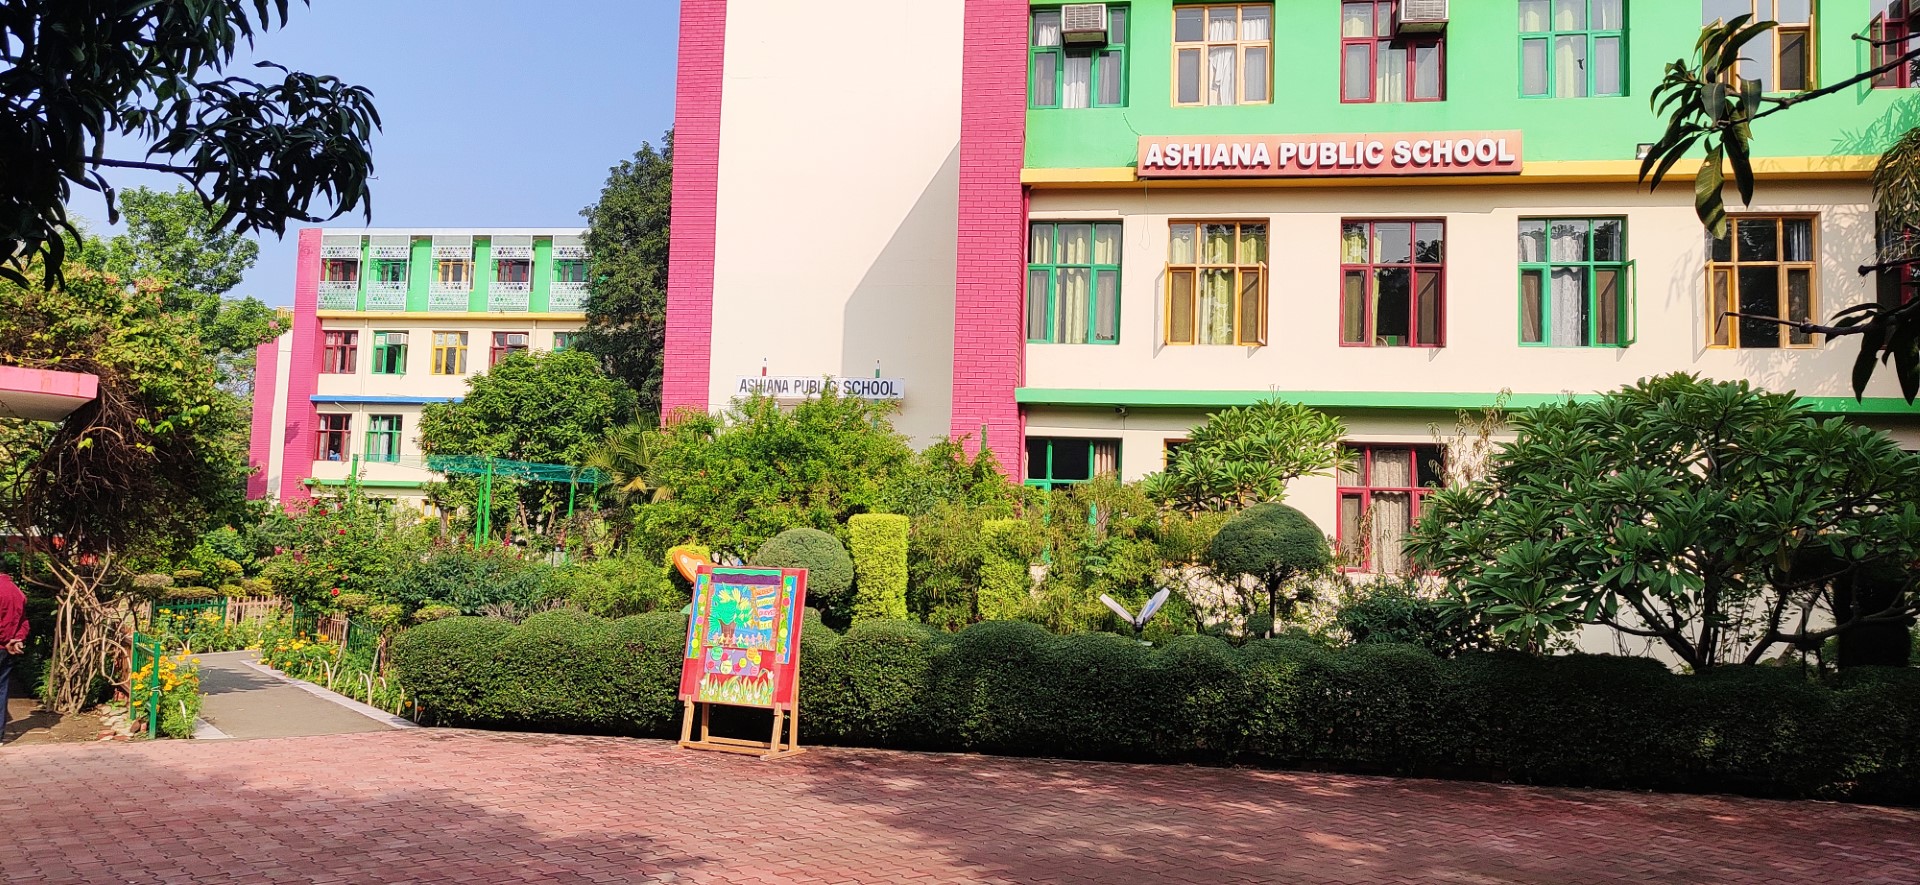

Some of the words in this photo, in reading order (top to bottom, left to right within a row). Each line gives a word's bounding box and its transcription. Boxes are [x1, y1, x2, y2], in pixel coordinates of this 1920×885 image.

[1144, 142, 1272, 169] ASHIANA
[1278, 140, 1385, 167] PUBLIC
[1392, 138, 1516, 165] SCHOOL
[739, 378, 789, 395] ASHIANA
[793, 379, 837, 396] PUBLC
[843, 380, 899, 396] SCHOOL
